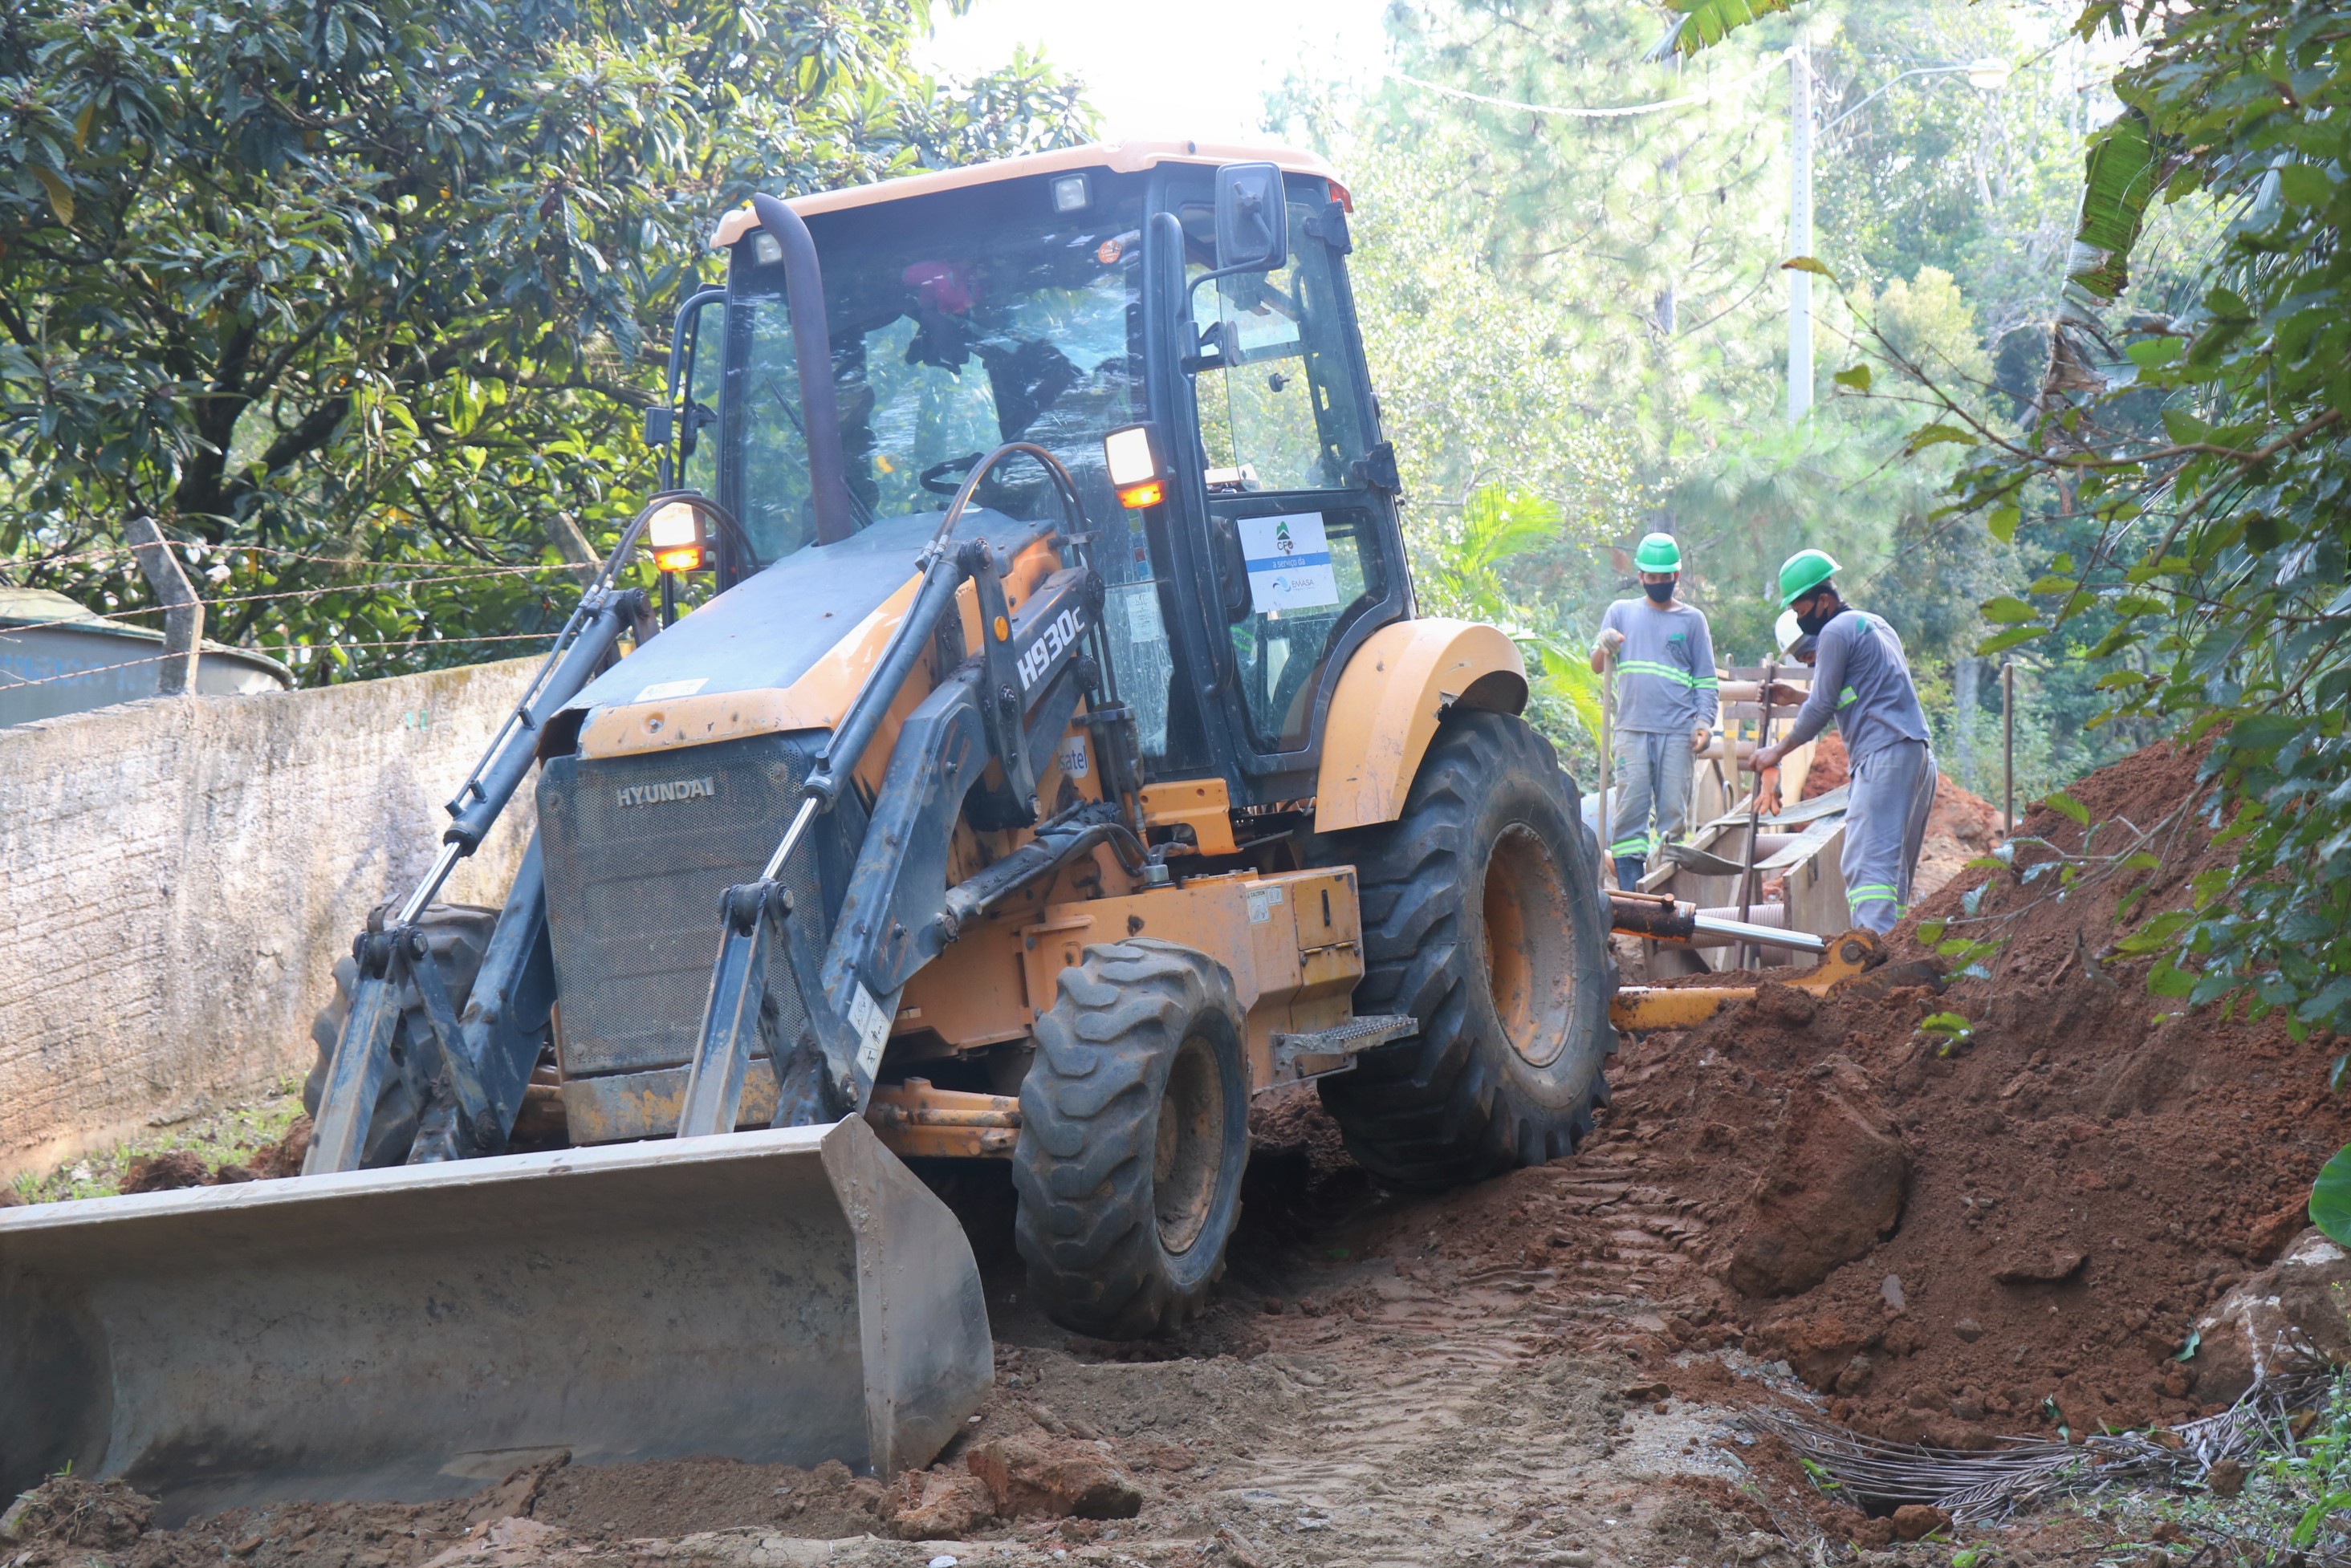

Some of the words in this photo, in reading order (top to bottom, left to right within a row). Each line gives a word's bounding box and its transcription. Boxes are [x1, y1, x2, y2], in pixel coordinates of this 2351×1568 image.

[1277, 559, 1297, 568] serviço
[1298, 556, 1306, 566] da
[1291, 579, 1314, 588] EMASA
[1017, 606, 1085, 691] H930C
[616, 776, 715, 807] HYUNDAI
